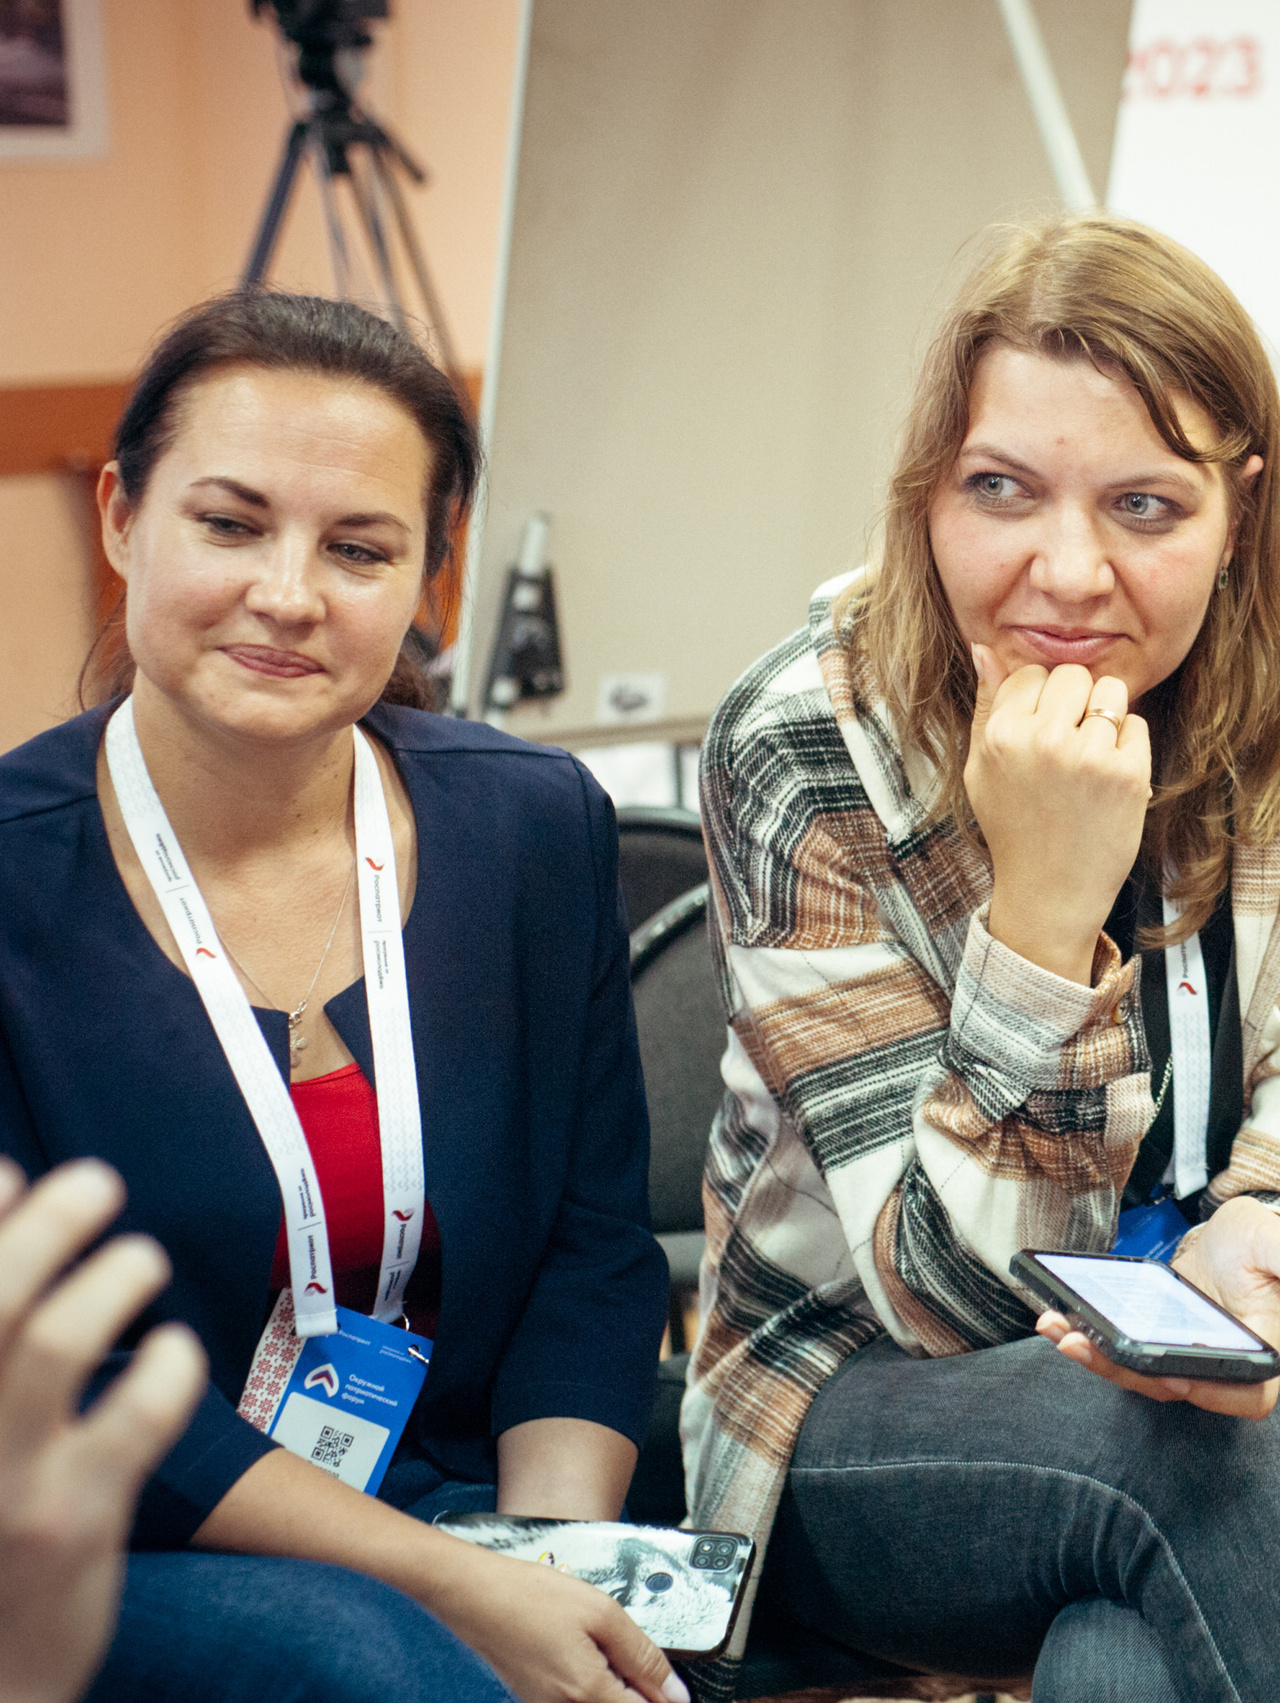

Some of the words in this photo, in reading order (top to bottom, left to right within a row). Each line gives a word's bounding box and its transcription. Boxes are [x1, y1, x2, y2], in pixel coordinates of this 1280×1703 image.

[374, 874, 383, 922] Роспатриот
[180, 897, 203, 945] Роспатриот
[1181, 942, 1189, 979] Роспатр
[308, 1234, 318, 1280] Роспатриот
[341, 1392, 365, 1405] форум
[344, 1384, 398, 1407] патриотический
[349, 1373, 385, 1392] Окружной
